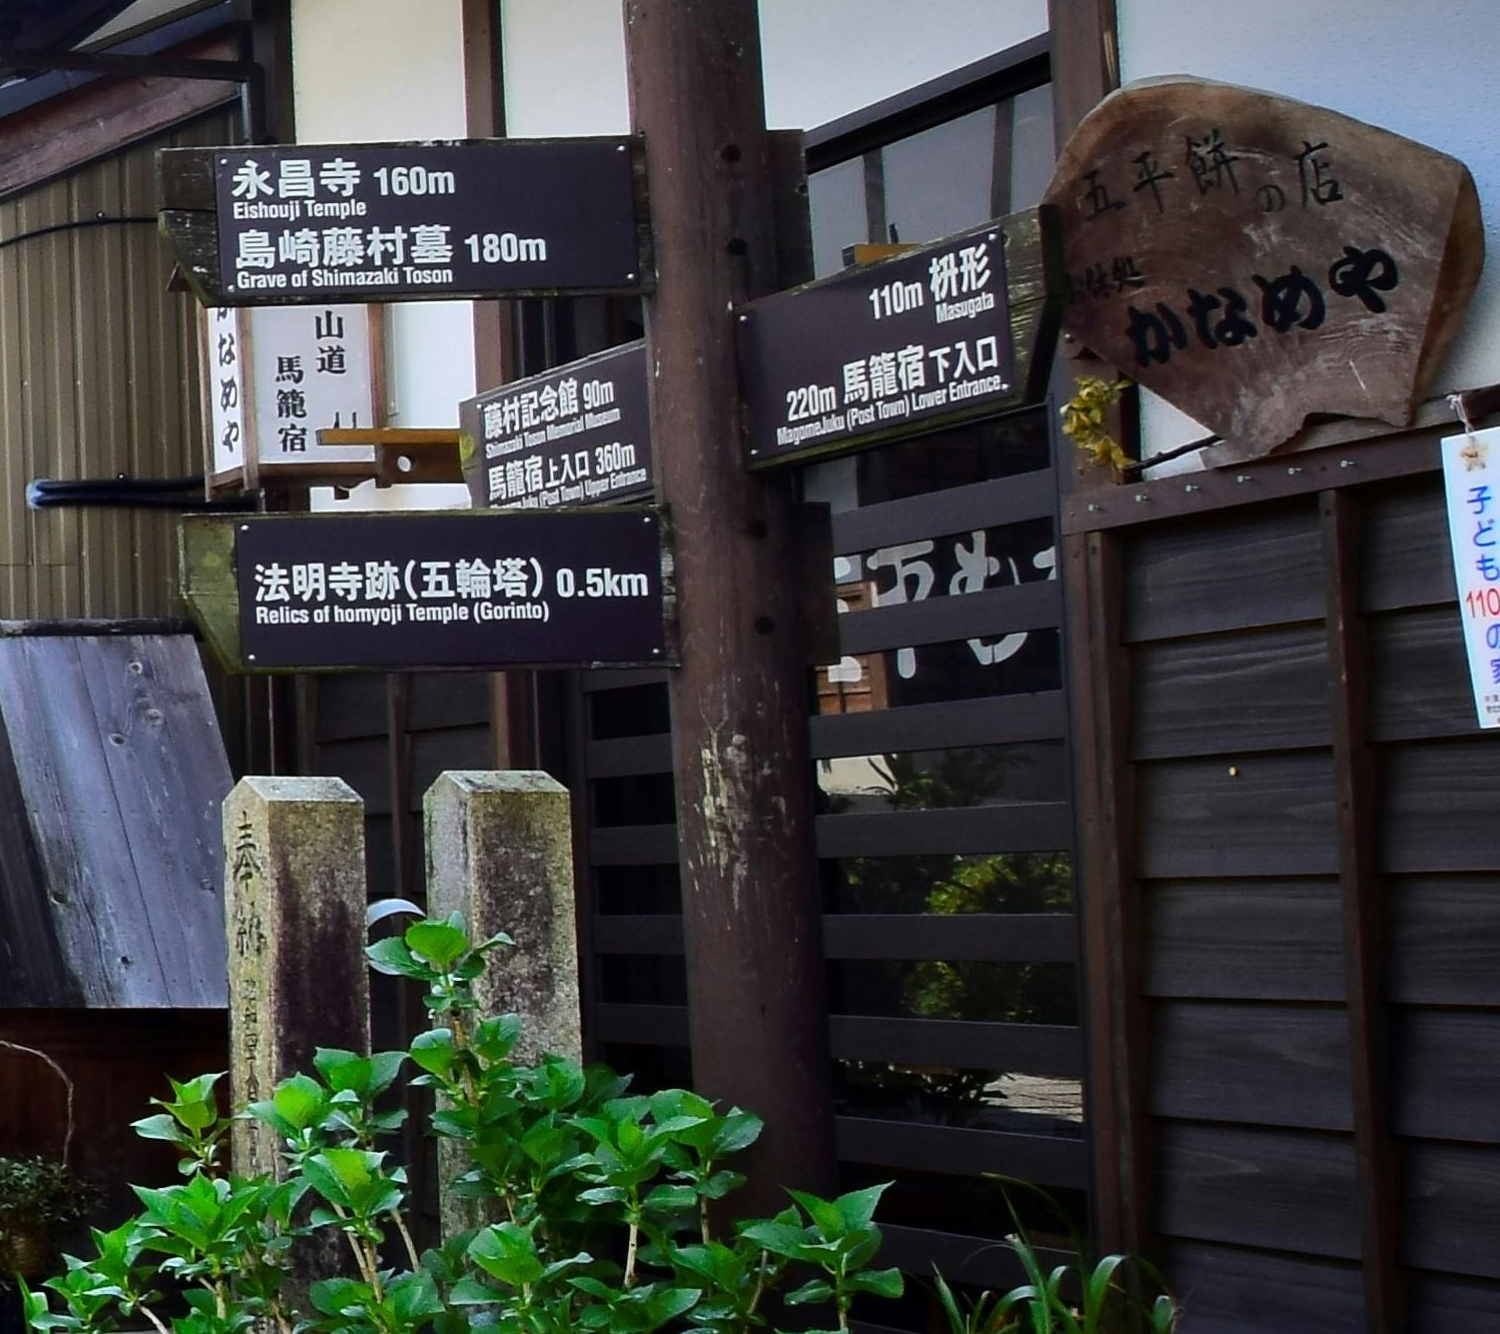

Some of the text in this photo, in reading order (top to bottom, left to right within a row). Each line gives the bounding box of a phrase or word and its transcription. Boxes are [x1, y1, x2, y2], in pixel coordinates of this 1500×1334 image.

[232, 158, 455, 199] 永昌寺 160m
[1076, 127, 1343, 217] 五平餅の店
[233, 199, 367, 221] Eishouji Temple
[236, 224, 546, 269] 島崎藤村墓 180m
[237, 267, 453, 288] Grave of Shimazaki Toson
[869, 243, 991, 319] 110m 枡形
[935, 292, 995, 324] Masugata
[1125, 246, 1399, 367] かなめや
[275, 355, 307, 452] 馬籠宿
[484, 377, 614, 439] 藤村記念館 90m
[786, 384, 836, 421] 220m
[846, 404, 875, 431] (Post
[876, 396, 909, 421] Town)
[912, 388, 948, 411] Lower
[949, 375, 1001, 401] Entrance
[485, 408, 621, 459] Shimazaki Toson Memorial Museum
[595, 442, 636, 475] 360m
[560, 481, 584, 504] Town)
[584, 477, 610, 498] Upper
[610, 468, 647, 490] Entrance
[556, 568, 648, 599] 0.5km
[256, 600, 549, 626] Relics of homyoji Temple (Gorinto)
